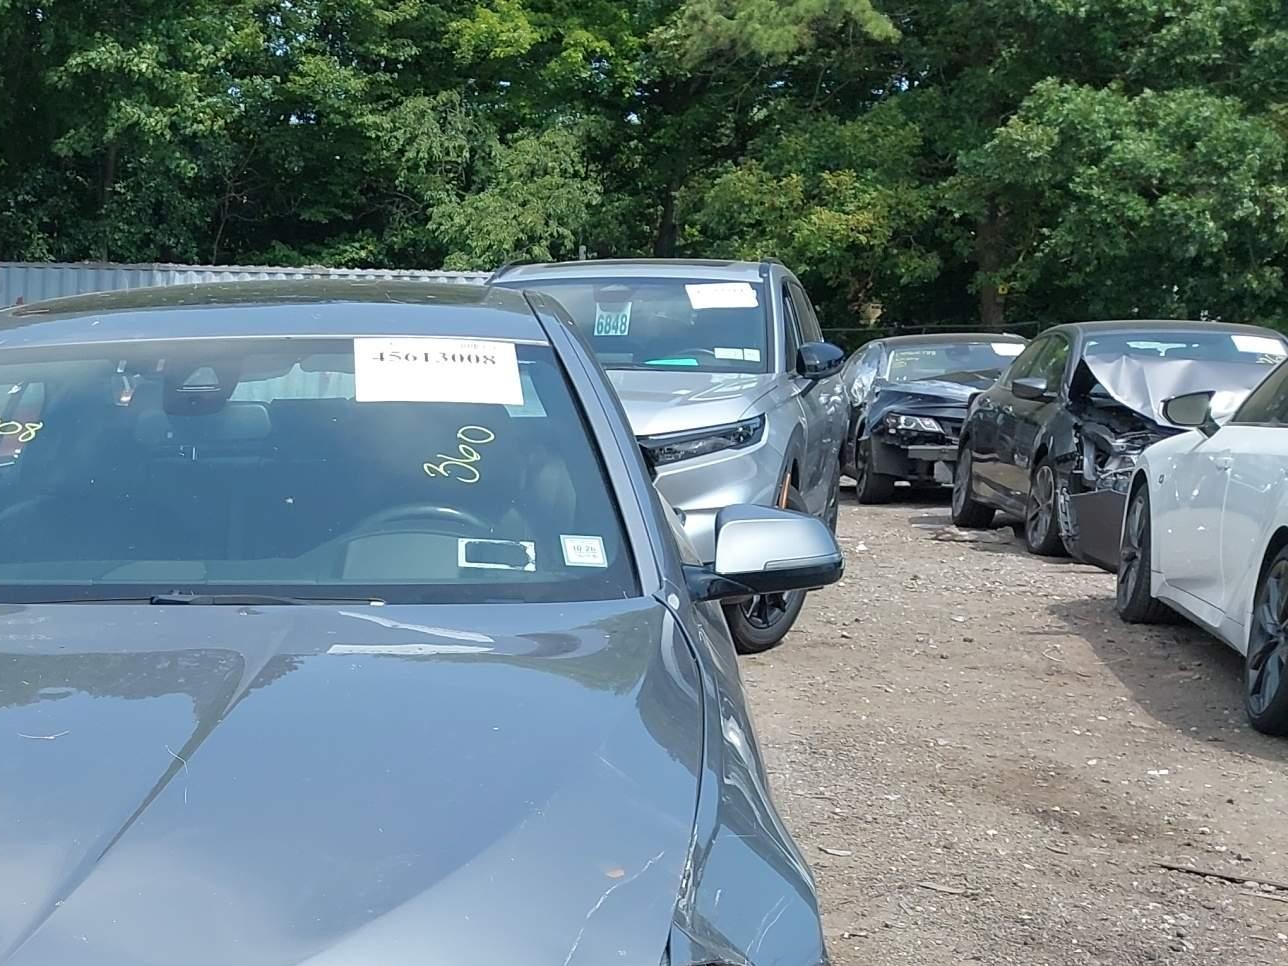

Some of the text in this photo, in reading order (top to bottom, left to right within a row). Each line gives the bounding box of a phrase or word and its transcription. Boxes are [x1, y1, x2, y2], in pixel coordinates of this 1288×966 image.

[596, 313, 628, 335] 6848
[371, 351, 497, 365] 45613008
[423, 425, 496, 483] 360
